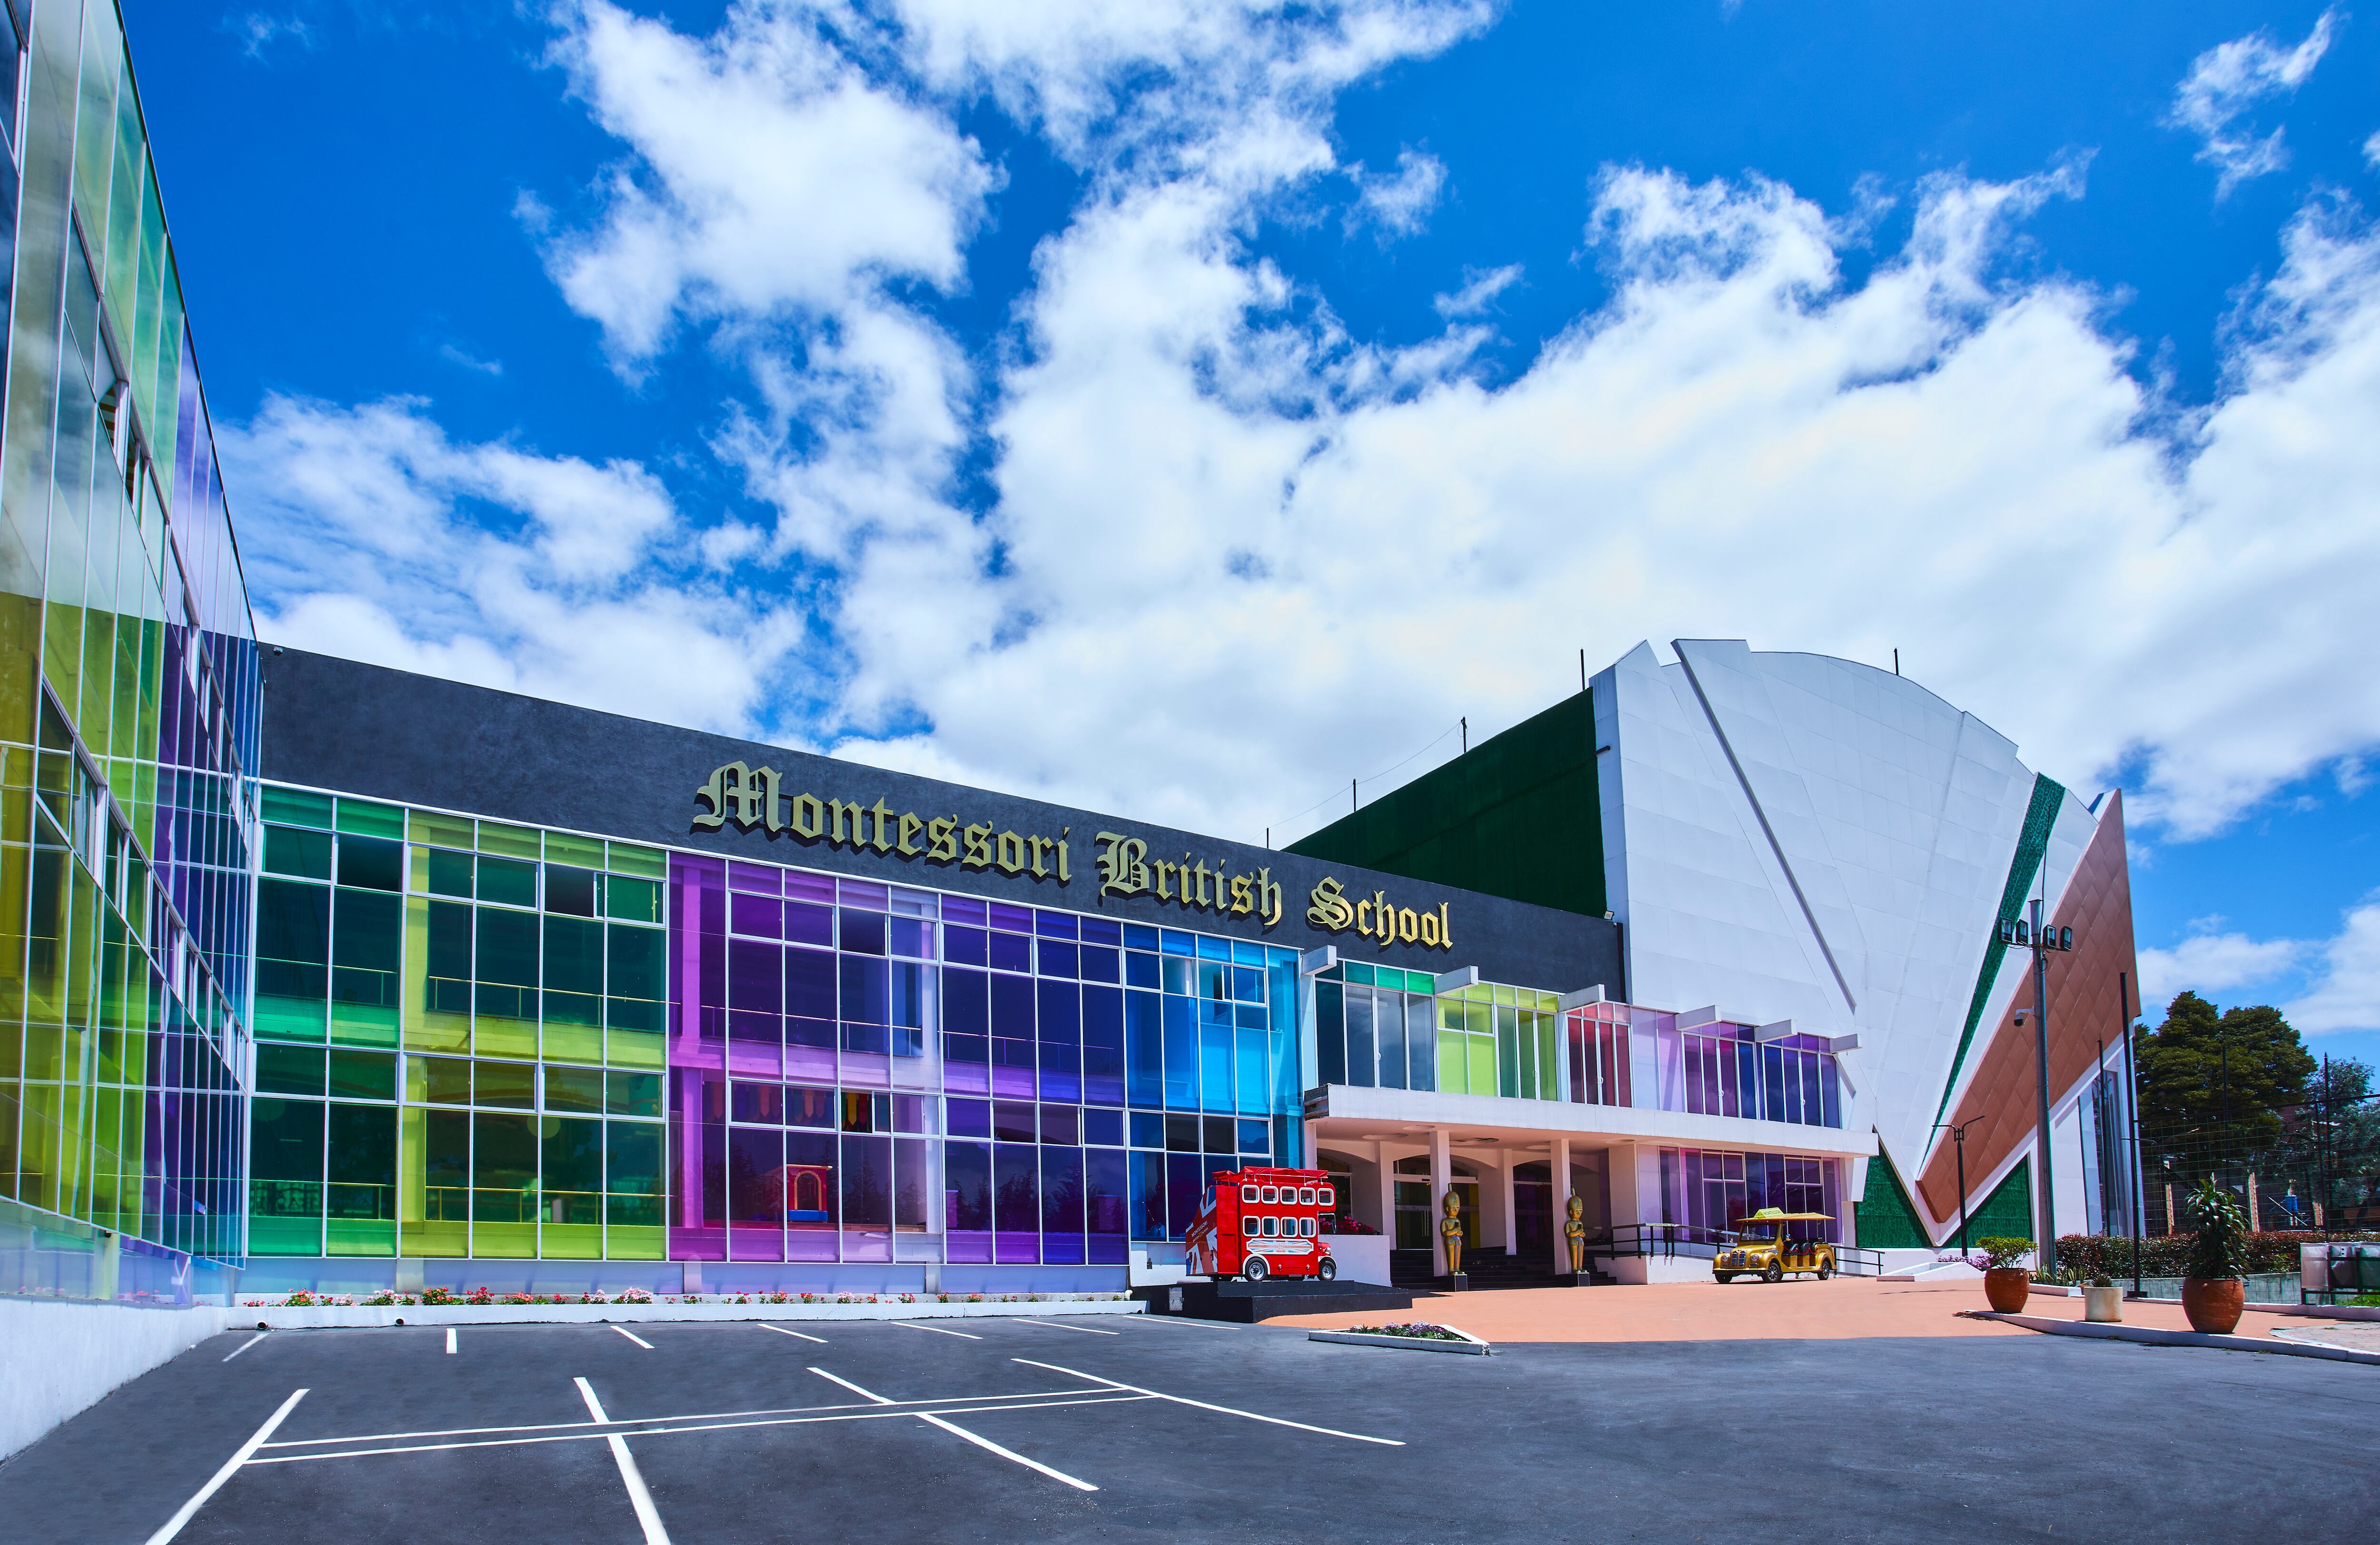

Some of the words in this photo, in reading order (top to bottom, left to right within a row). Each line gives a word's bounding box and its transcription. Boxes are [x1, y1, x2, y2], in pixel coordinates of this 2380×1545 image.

[692, 761, 1072, 881] Montessori
[1095, 831, 1282, 926] British
[1307, 876, 1453, 949] School
[1191, 1220, 1208, 1238] MONTESSORI
